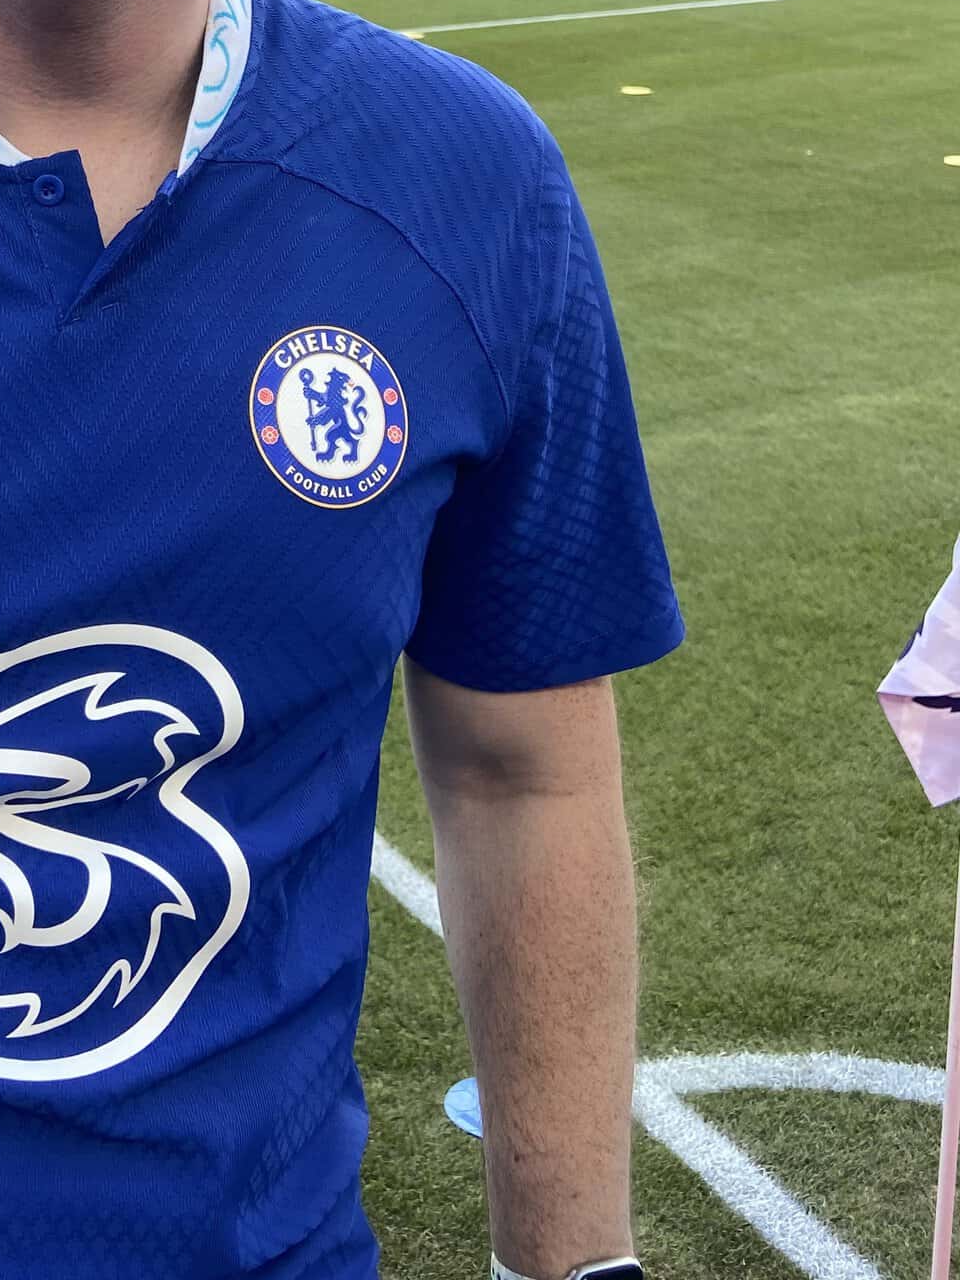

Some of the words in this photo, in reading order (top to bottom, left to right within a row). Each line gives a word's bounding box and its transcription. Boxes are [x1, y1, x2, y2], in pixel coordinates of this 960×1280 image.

[274, 332, 376, 371] CHELSEA
[285, 465, 353, 498] FOOTBALL
[358, 463, 388, 492] CLUB
